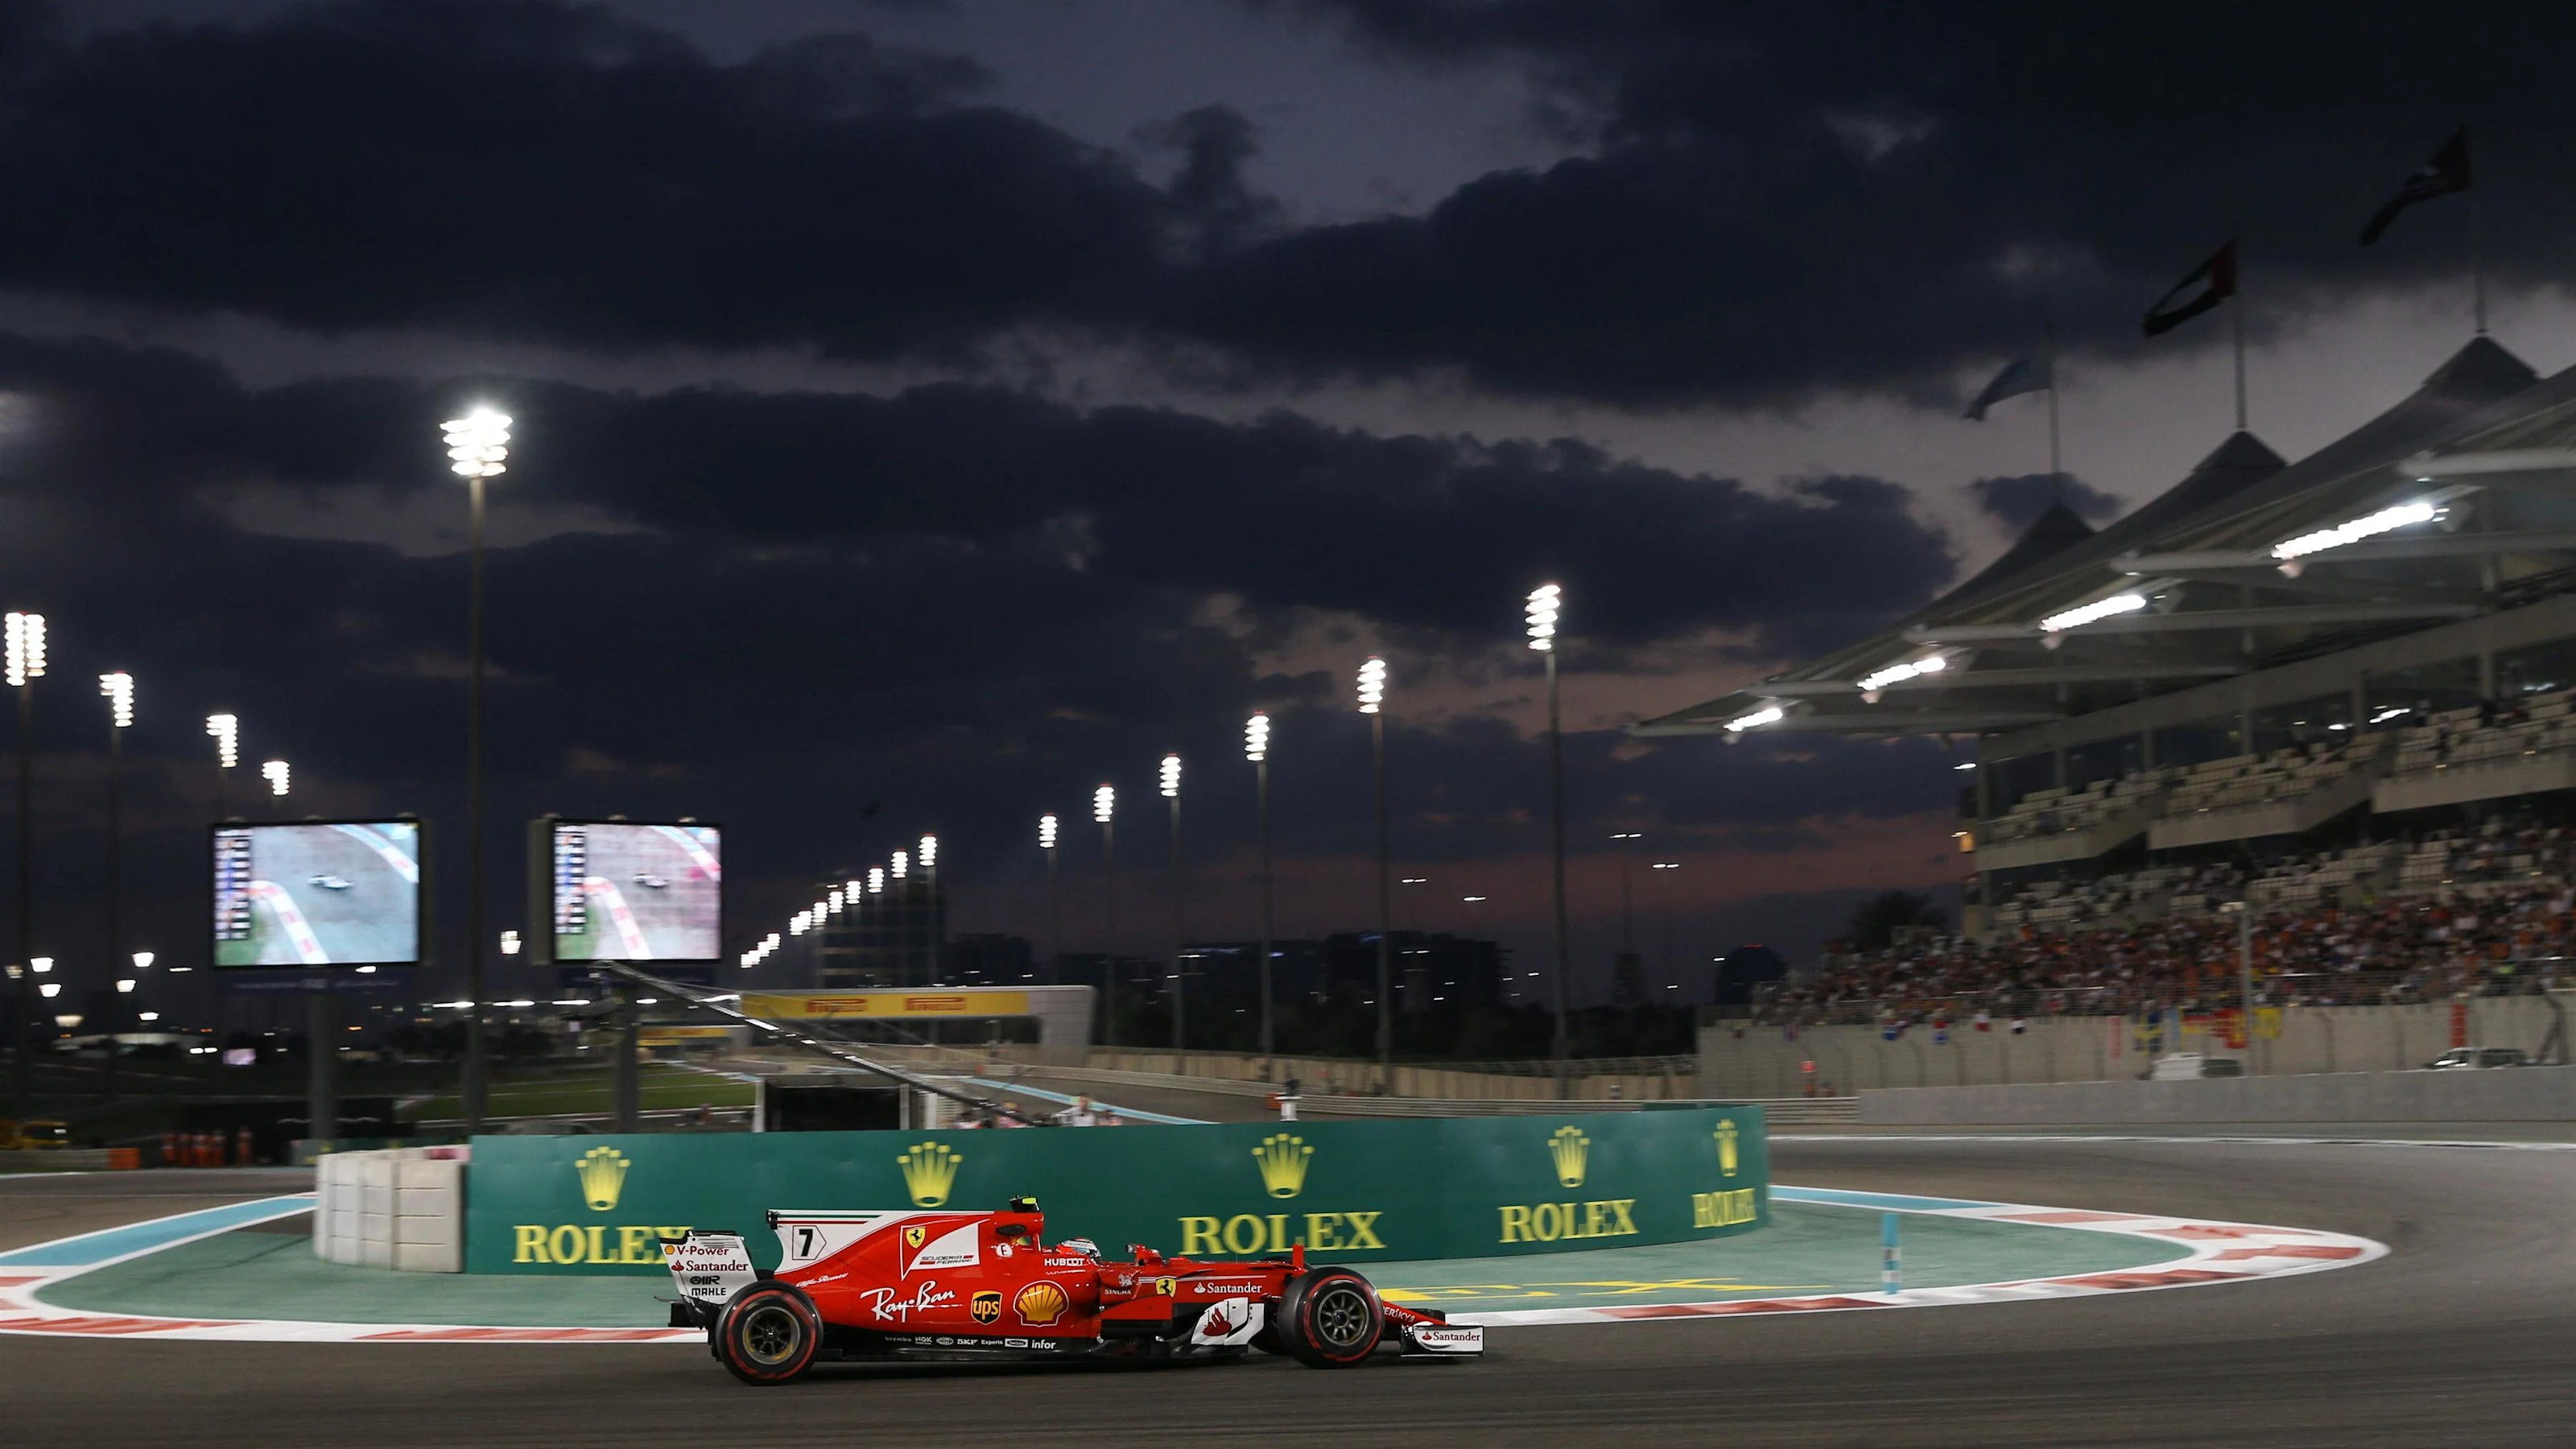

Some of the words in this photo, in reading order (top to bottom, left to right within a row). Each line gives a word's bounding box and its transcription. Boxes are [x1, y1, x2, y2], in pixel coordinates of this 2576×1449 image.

[1497, 1199, 1639, 1243] ROLEX
[1178, 1212, 1387, 1256] ROLEX
[799, 1228, 813, 1257] 7
[678, 1245, 729, 1256] V-Power
[686, 1260, 749, 1271] Santander
[1044, 1258, 1084, 1266] HUBLOT
[691, 1287, 726, 1296] MAHLE
[1207, 1282, 1262, 1293] Santander
[973, 1300, 999, 1320] ups
[1433, 1331, 1481, 1342] Santander
[1031, 1339, 1056, 1349] infor
